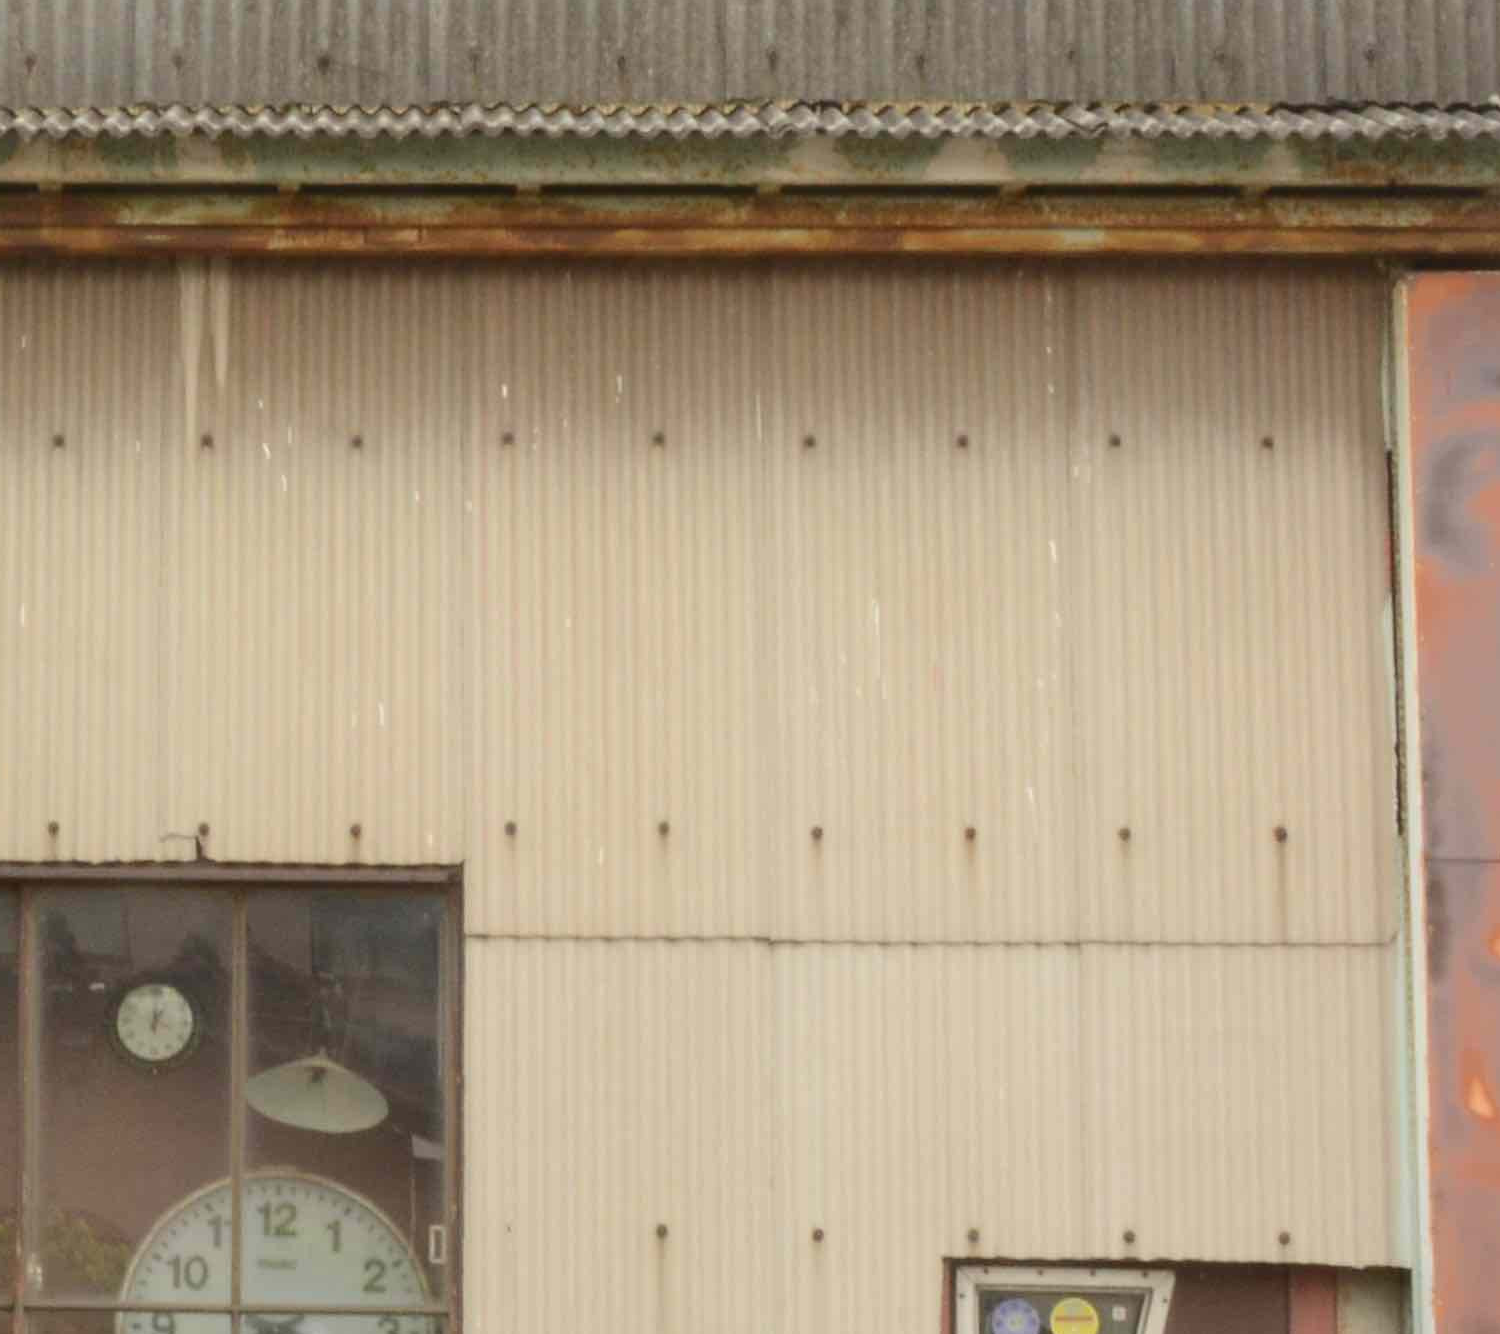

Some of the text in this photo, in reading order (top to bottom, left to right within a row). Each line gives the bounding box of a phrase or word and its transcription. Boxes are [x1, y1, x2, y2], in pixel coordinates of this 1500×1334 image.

[258, 1200, 298, 1238] 12
[327, 1218, 342, 1253] 1
[166, 1254, 209, 1291] 10
[362, 1258, 387, 1294] 2
